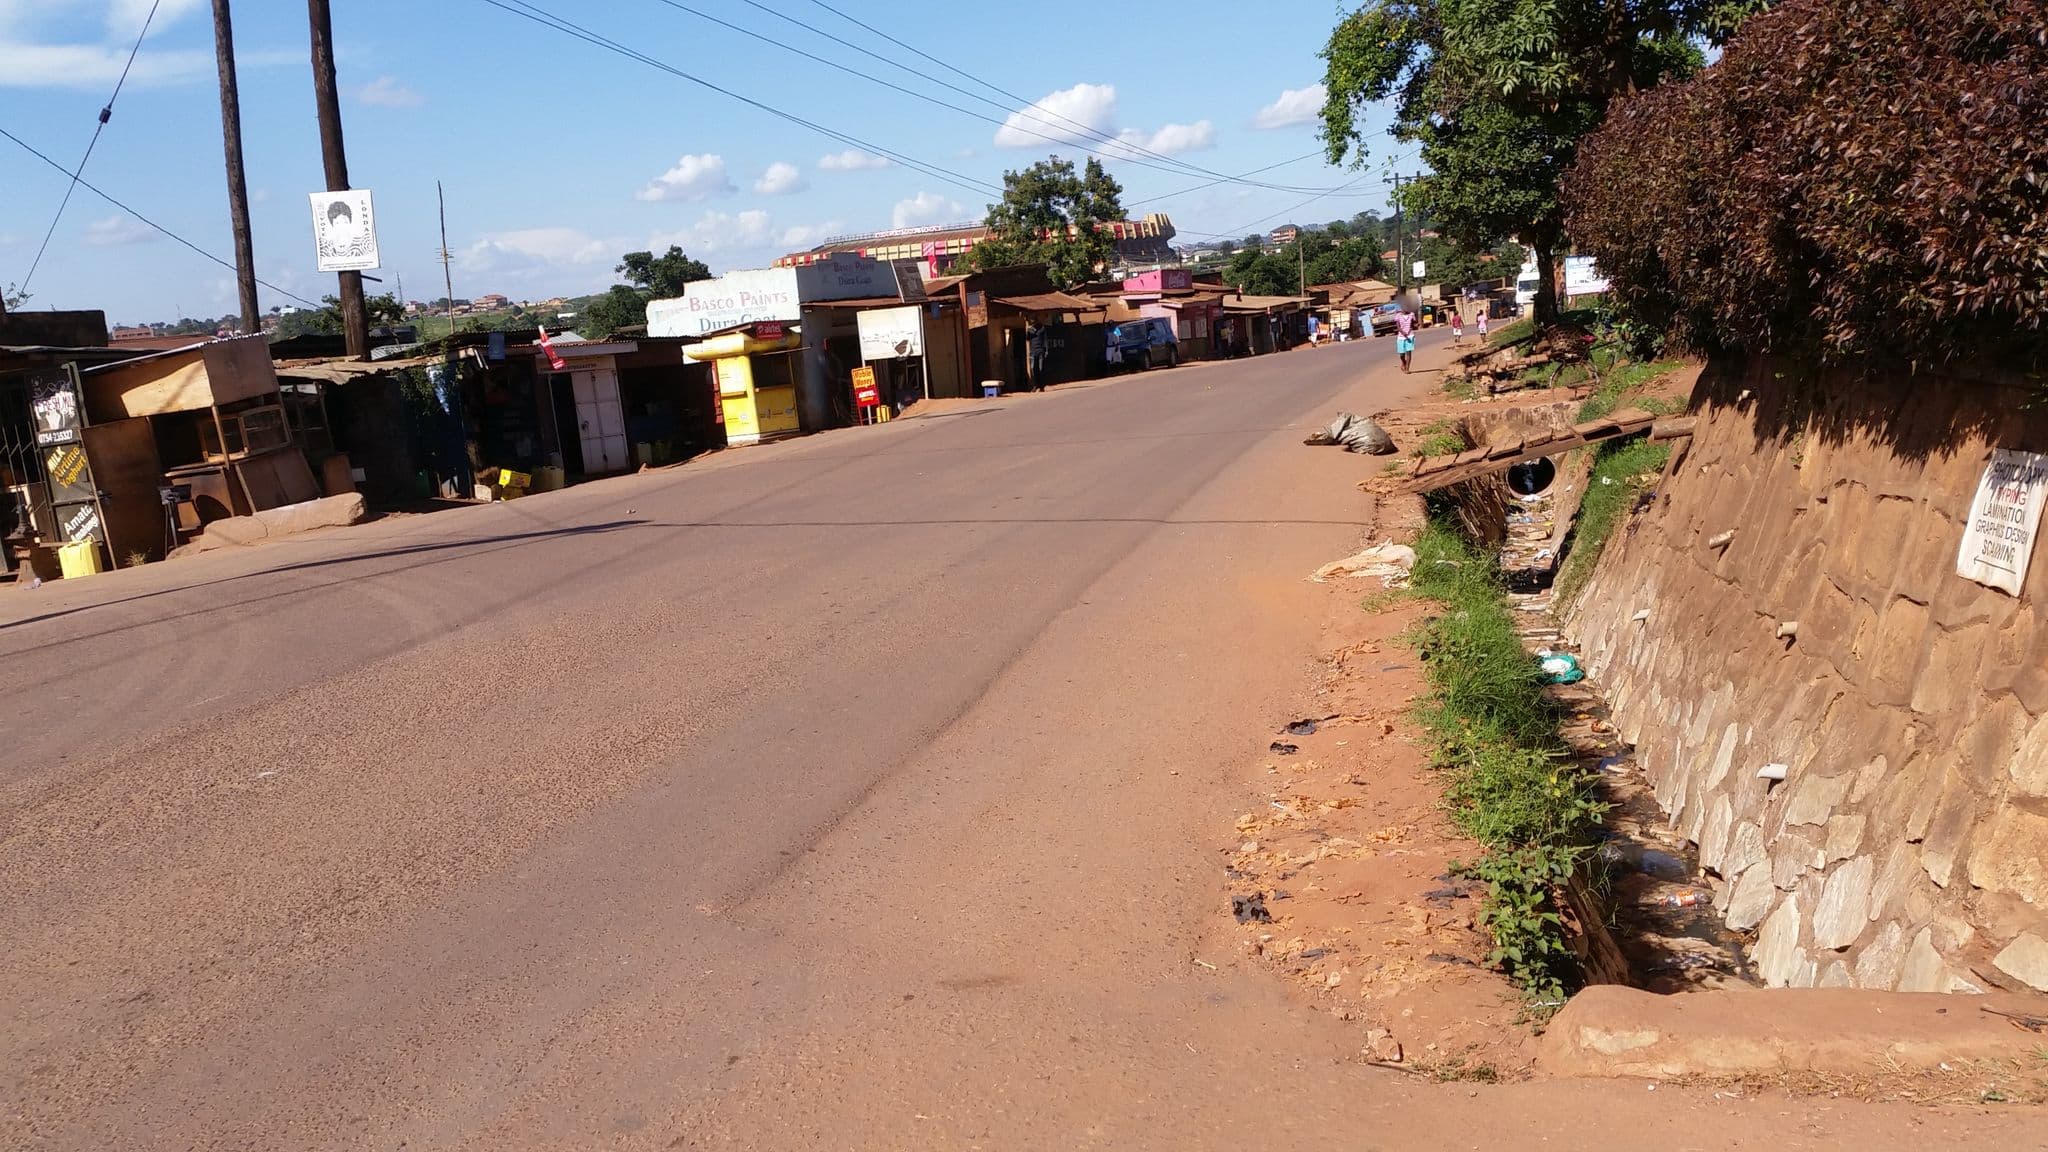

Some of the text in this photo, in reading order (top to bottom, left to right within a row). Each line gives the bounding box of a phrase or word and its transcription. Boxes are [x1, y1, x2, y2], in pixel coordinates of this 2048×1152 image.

[689, 297, 734, 312] BASCO
[699, 317, 737, 333] Dura
[53, 447, 80, 482] Airtime
[1994, 461, 2044, 484] PHOTOCOPY
[1996, 486, 2028, 506] TYPING
[64, 504, 93, 535] Amata
